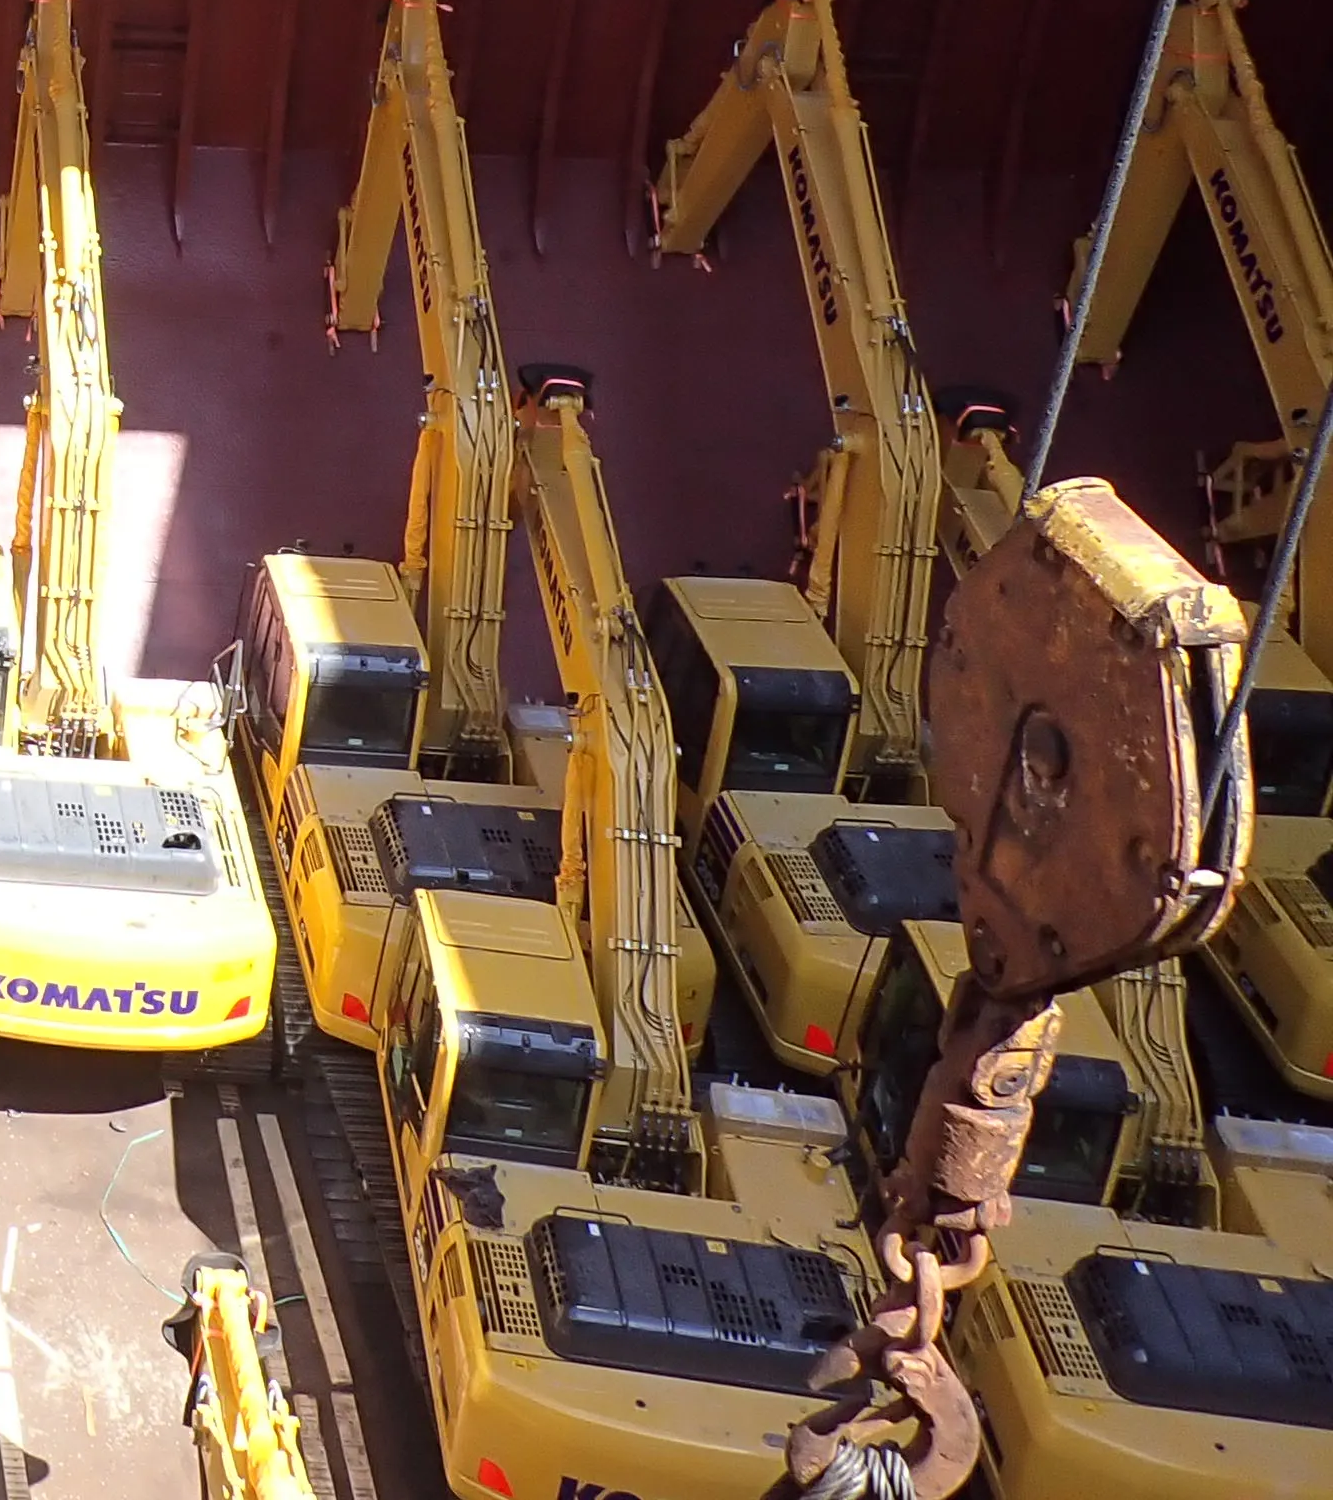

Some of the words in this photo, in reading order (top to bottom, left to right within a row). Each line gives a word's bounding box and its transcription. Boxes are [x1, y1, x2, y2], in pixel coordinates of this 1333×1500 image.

[402, 141, 433, 313] KOMATSU
[788, 145, 838, 325] KOMATSU
[1209, 167, 1283, 344] KOMATSU
